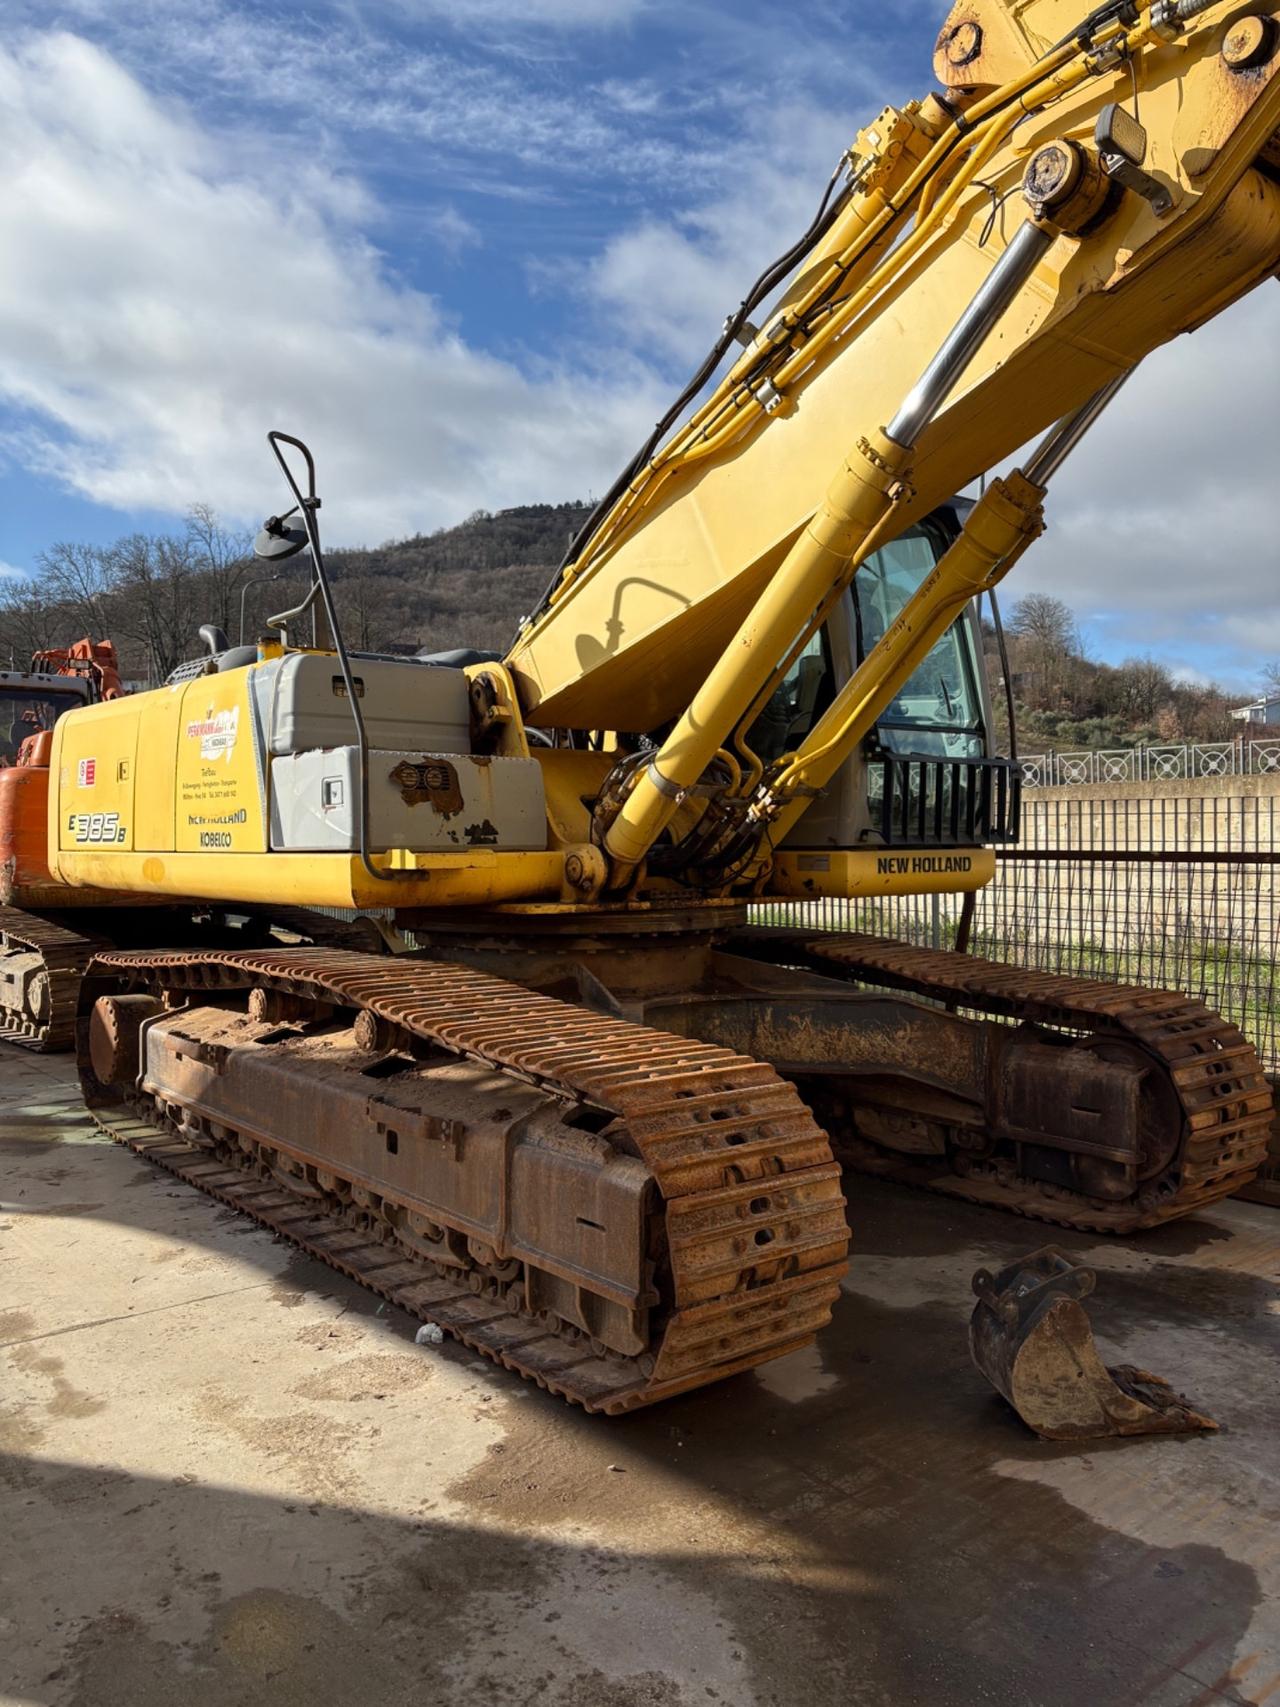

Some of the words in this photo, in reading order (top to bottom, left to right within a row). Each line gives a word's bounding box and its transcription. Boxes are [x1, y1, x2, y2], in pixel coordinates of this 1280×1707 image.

[200, 831, 231, 847] KOBELCO
[877, 857, 909, 874] NEW
[912, 856, 972, 873] HOLLAND
